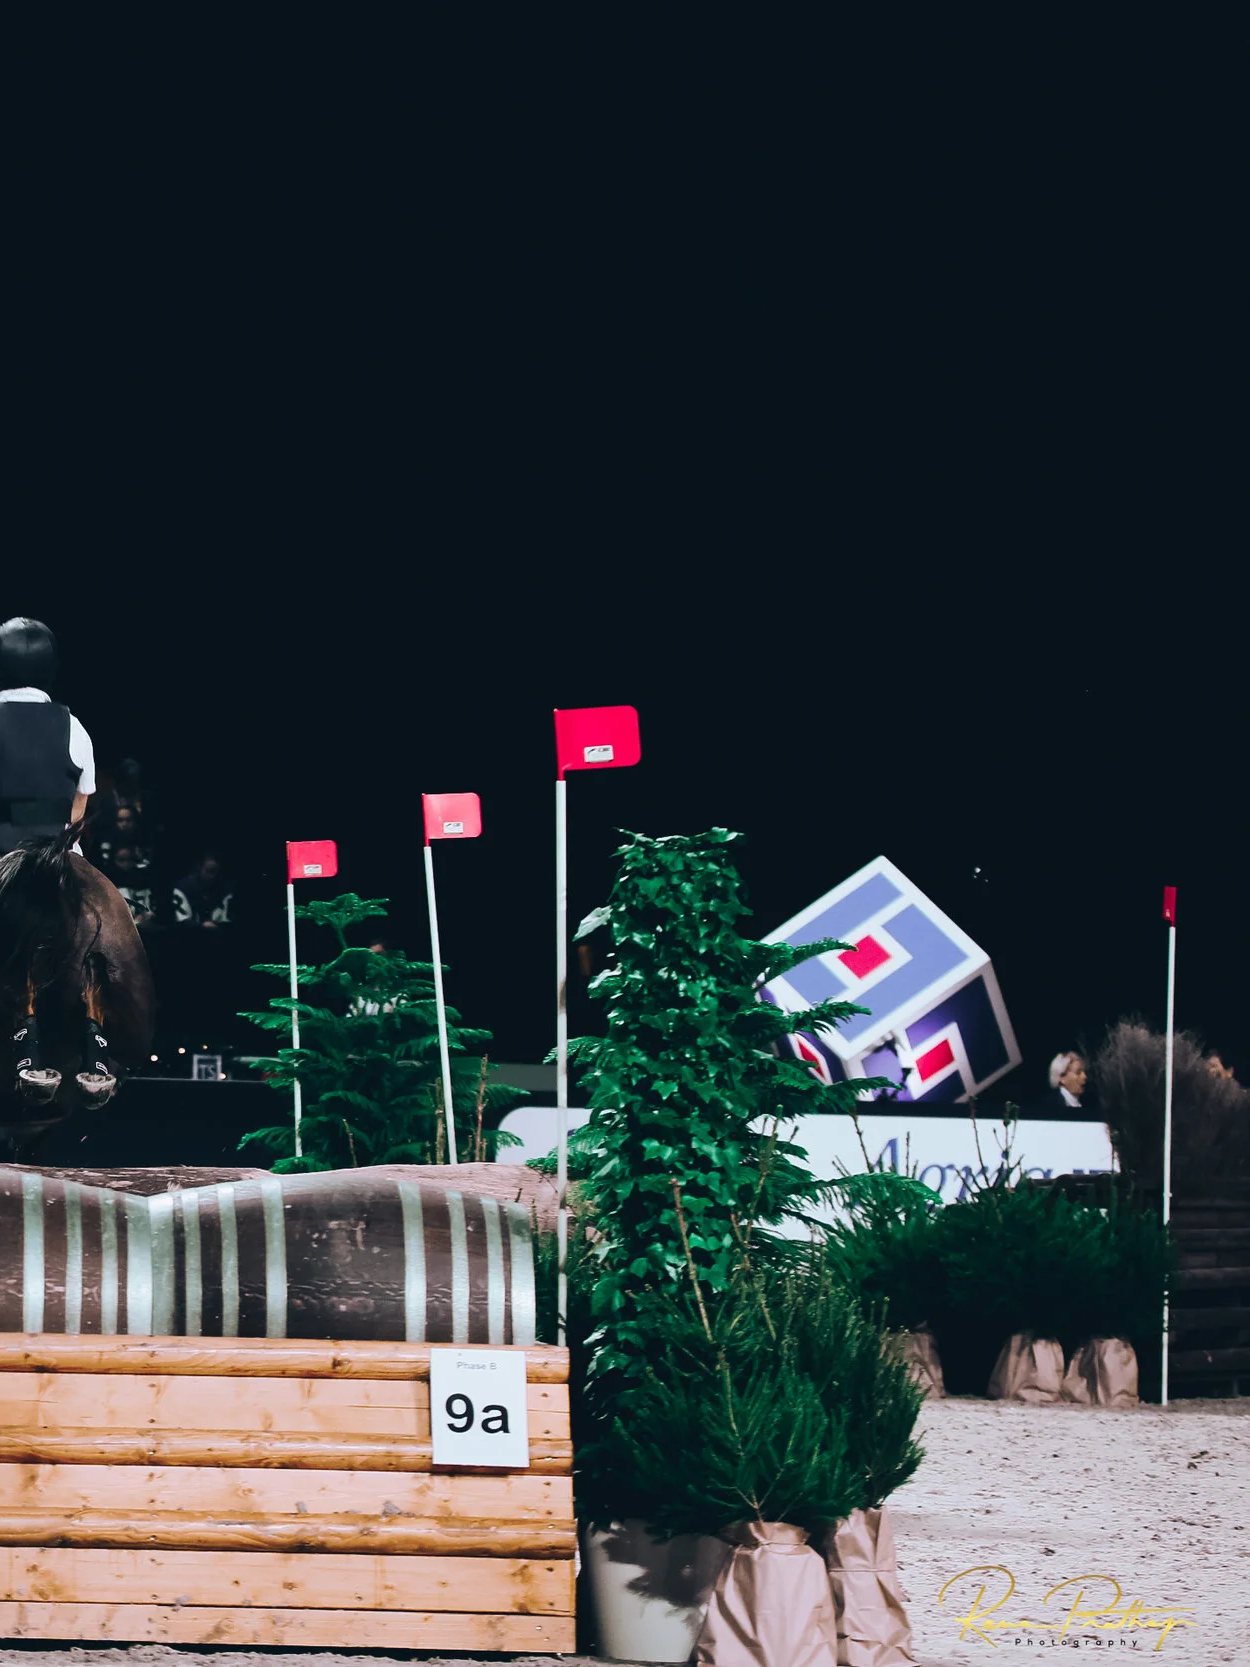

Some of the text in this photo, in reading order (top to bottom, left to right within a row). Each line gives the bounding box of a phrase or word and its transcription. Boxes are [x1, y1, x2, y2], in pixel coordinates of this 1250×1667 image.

[456, 1361, 498, 1370] Phase B
[445, 1393, 511, 1434] 9a
